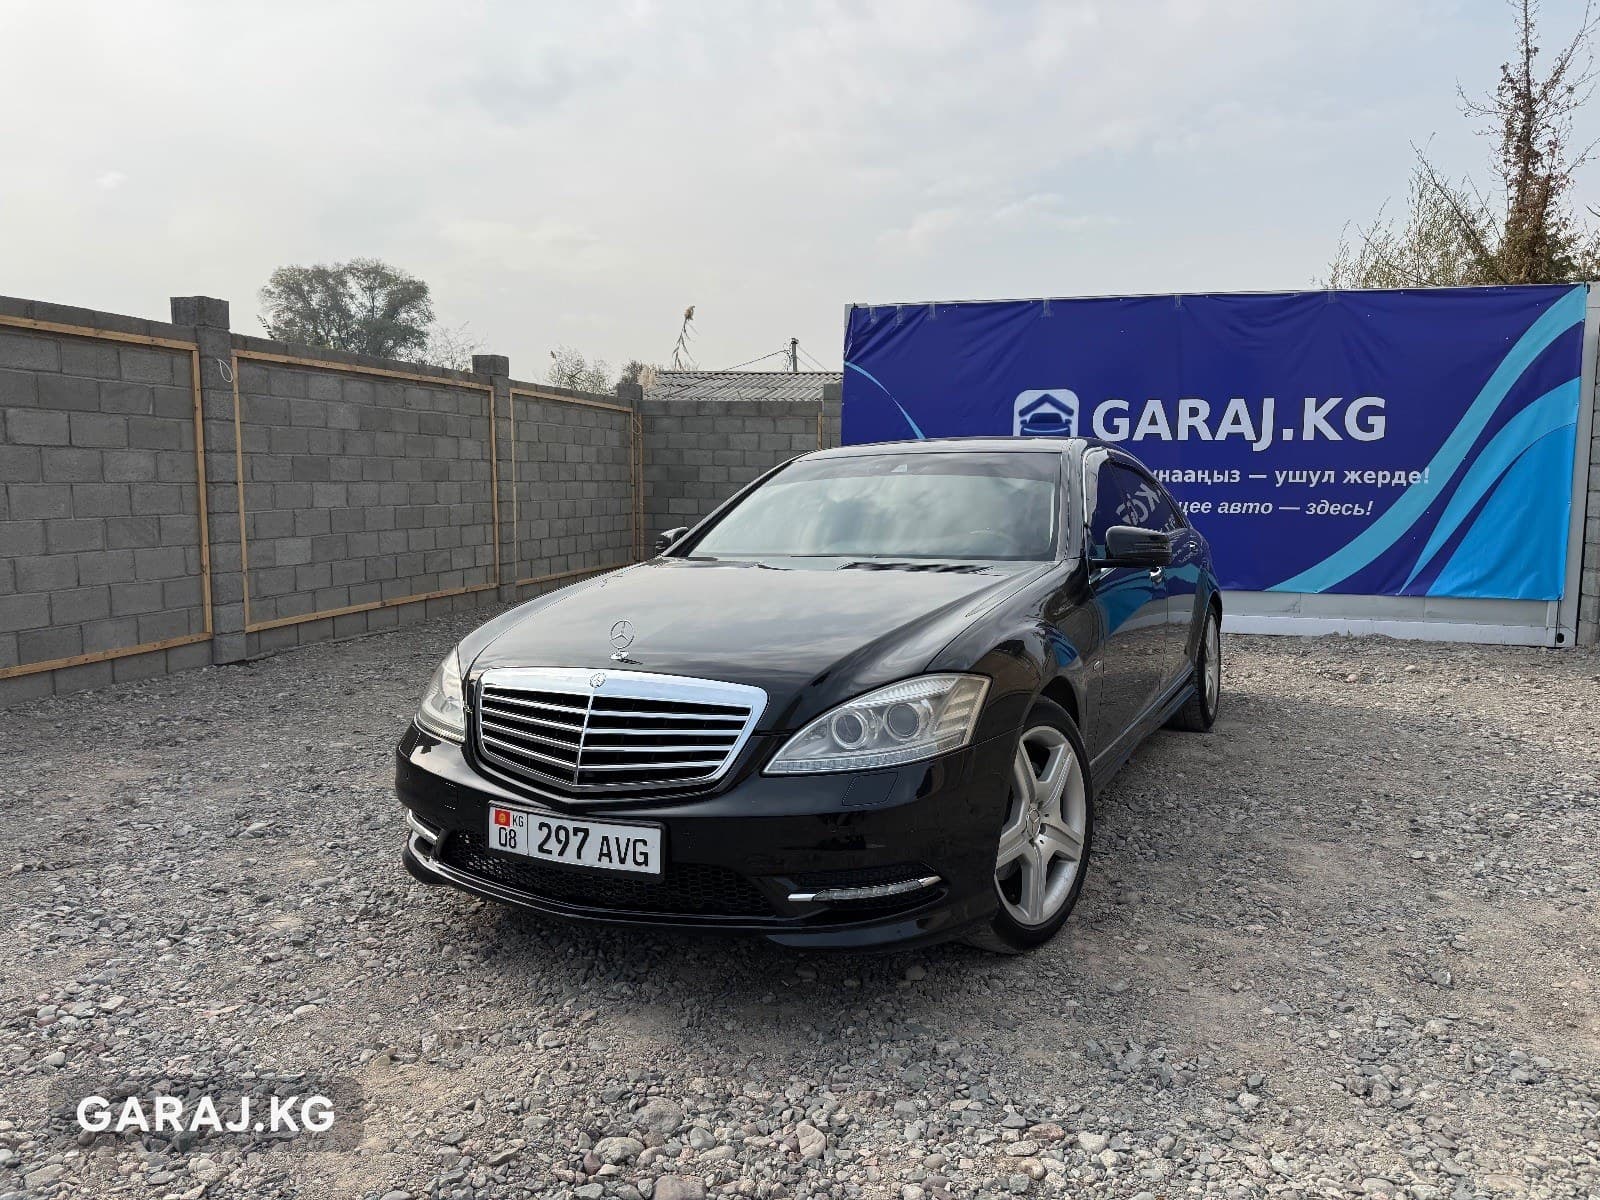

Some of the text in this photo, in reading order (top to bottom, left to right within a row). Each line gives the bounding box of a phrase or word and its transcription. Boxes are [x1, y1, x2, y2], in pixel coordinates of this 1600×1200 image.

[1092, 396, 1386, 451] GARAJ.KG
[1275, 470, 1335, 488] ушул
[1343, 467, 1430, 488] жерде!
[1217, 501, 1273, 515] авто
[1305, 499, 1374, 516] здесь!
[512, 814, 524, 828] KG
[499, 827, 517, 849] 08
[537, 821, 649, 867] 297 AVG
